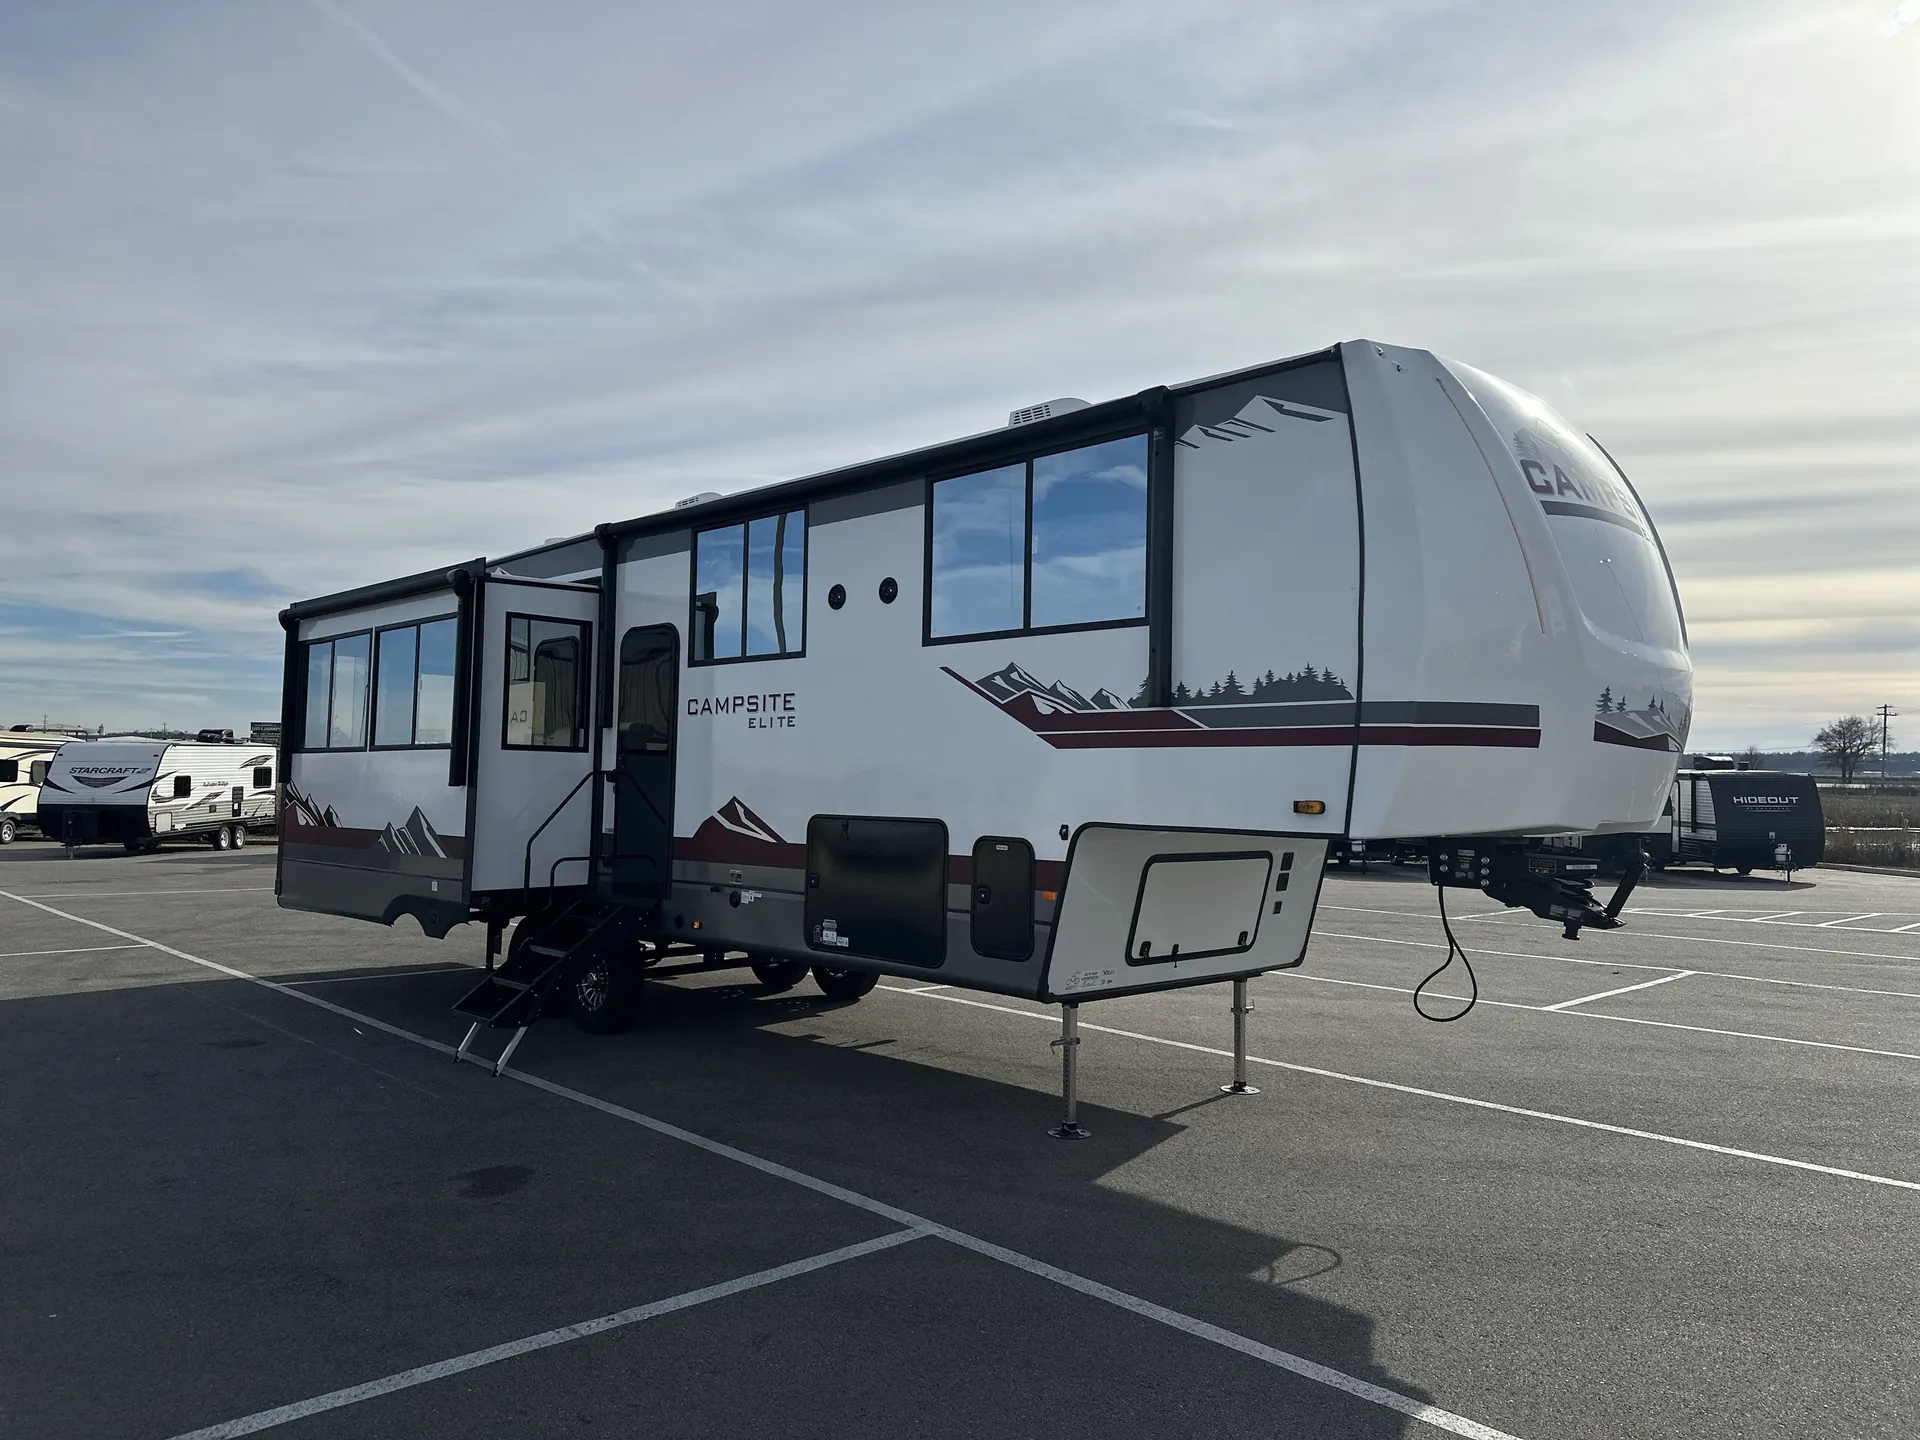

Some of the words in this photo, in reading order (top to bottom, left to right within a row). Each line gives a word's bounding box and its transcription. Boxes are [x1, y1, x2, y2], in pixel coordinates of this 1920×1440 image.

[687, 693, 796, 716] CAMPSITE
[748, 716, 796, 729] ELITE
[1733, 796, 1799, 804] HIDEOUT
